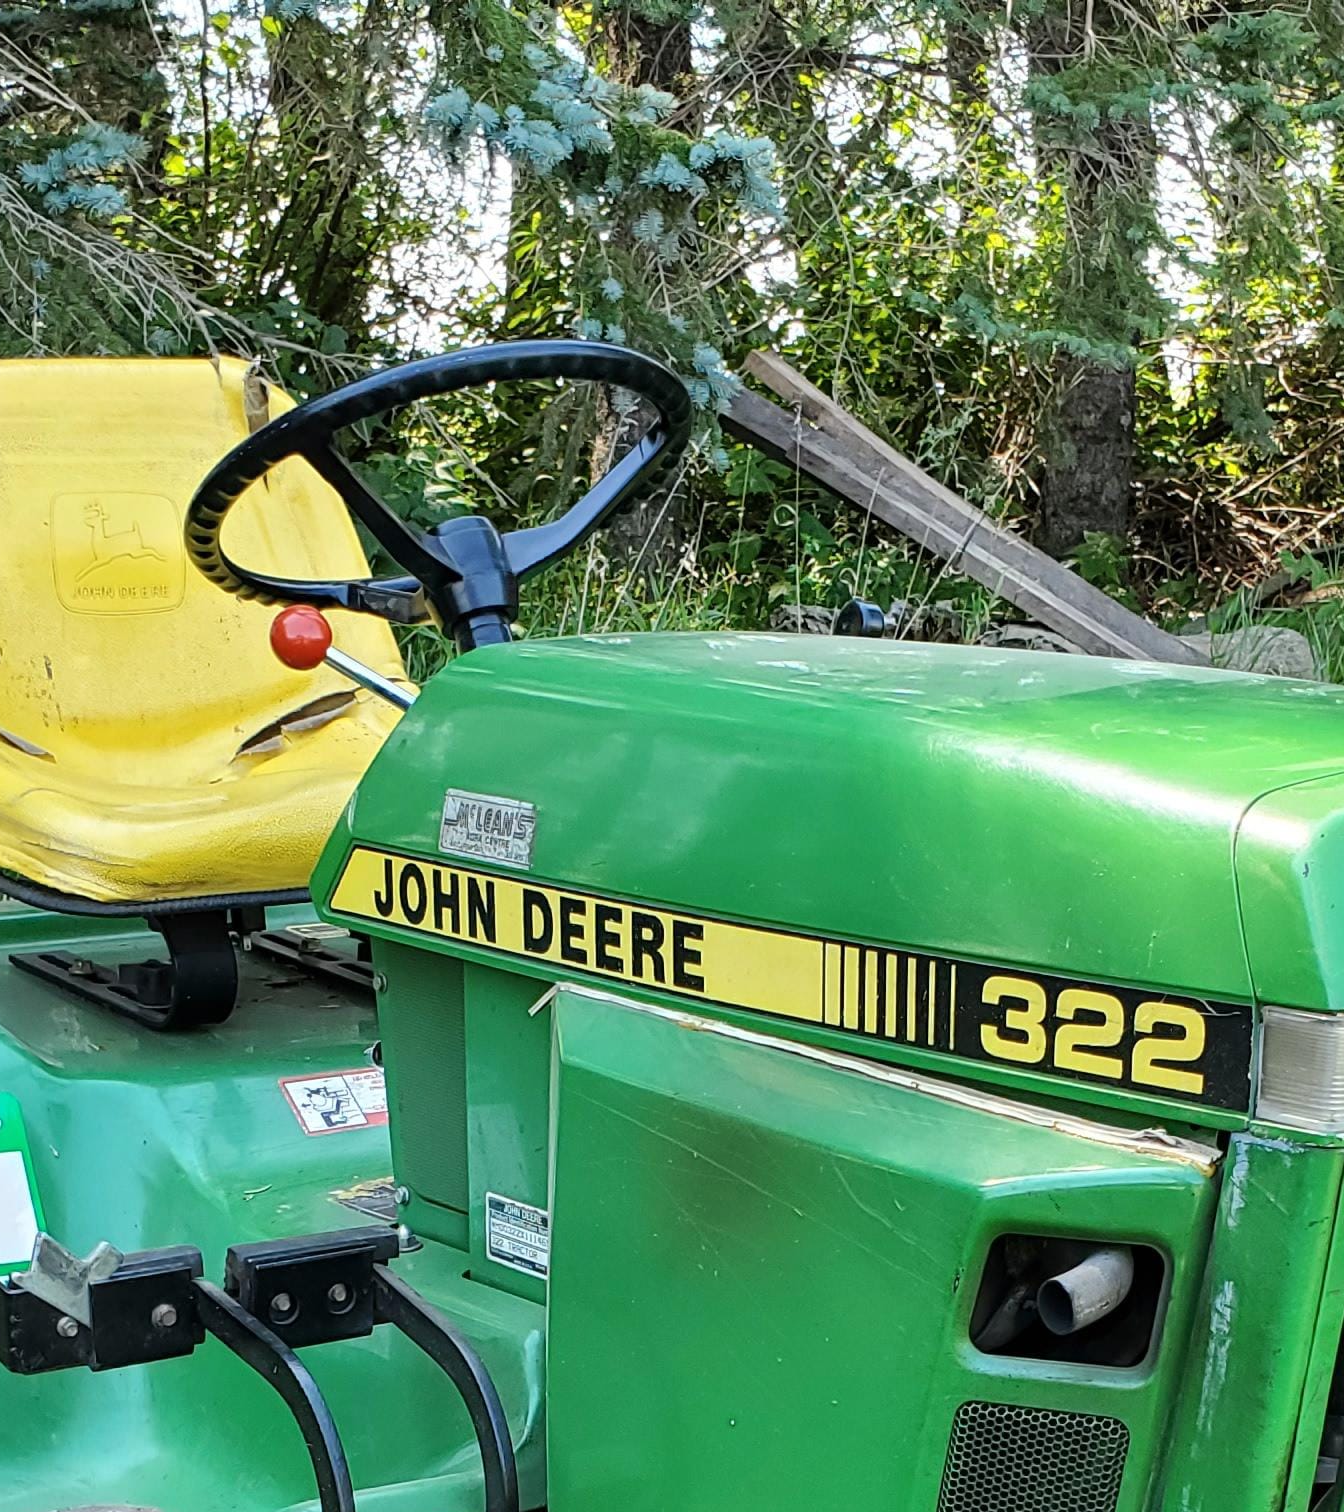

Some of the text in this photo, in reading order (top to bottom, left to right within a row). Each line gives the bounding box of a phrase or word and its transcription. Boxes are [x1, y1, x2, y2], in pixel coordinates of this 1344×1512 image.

[74, 585, 169, 600] JOHN DEERE
[374, 859, 705, 993] JOHN DEERE
[980, 975, 1205, 1095] 322
[503, 1203, 543, 1224] JOHN DEERE
